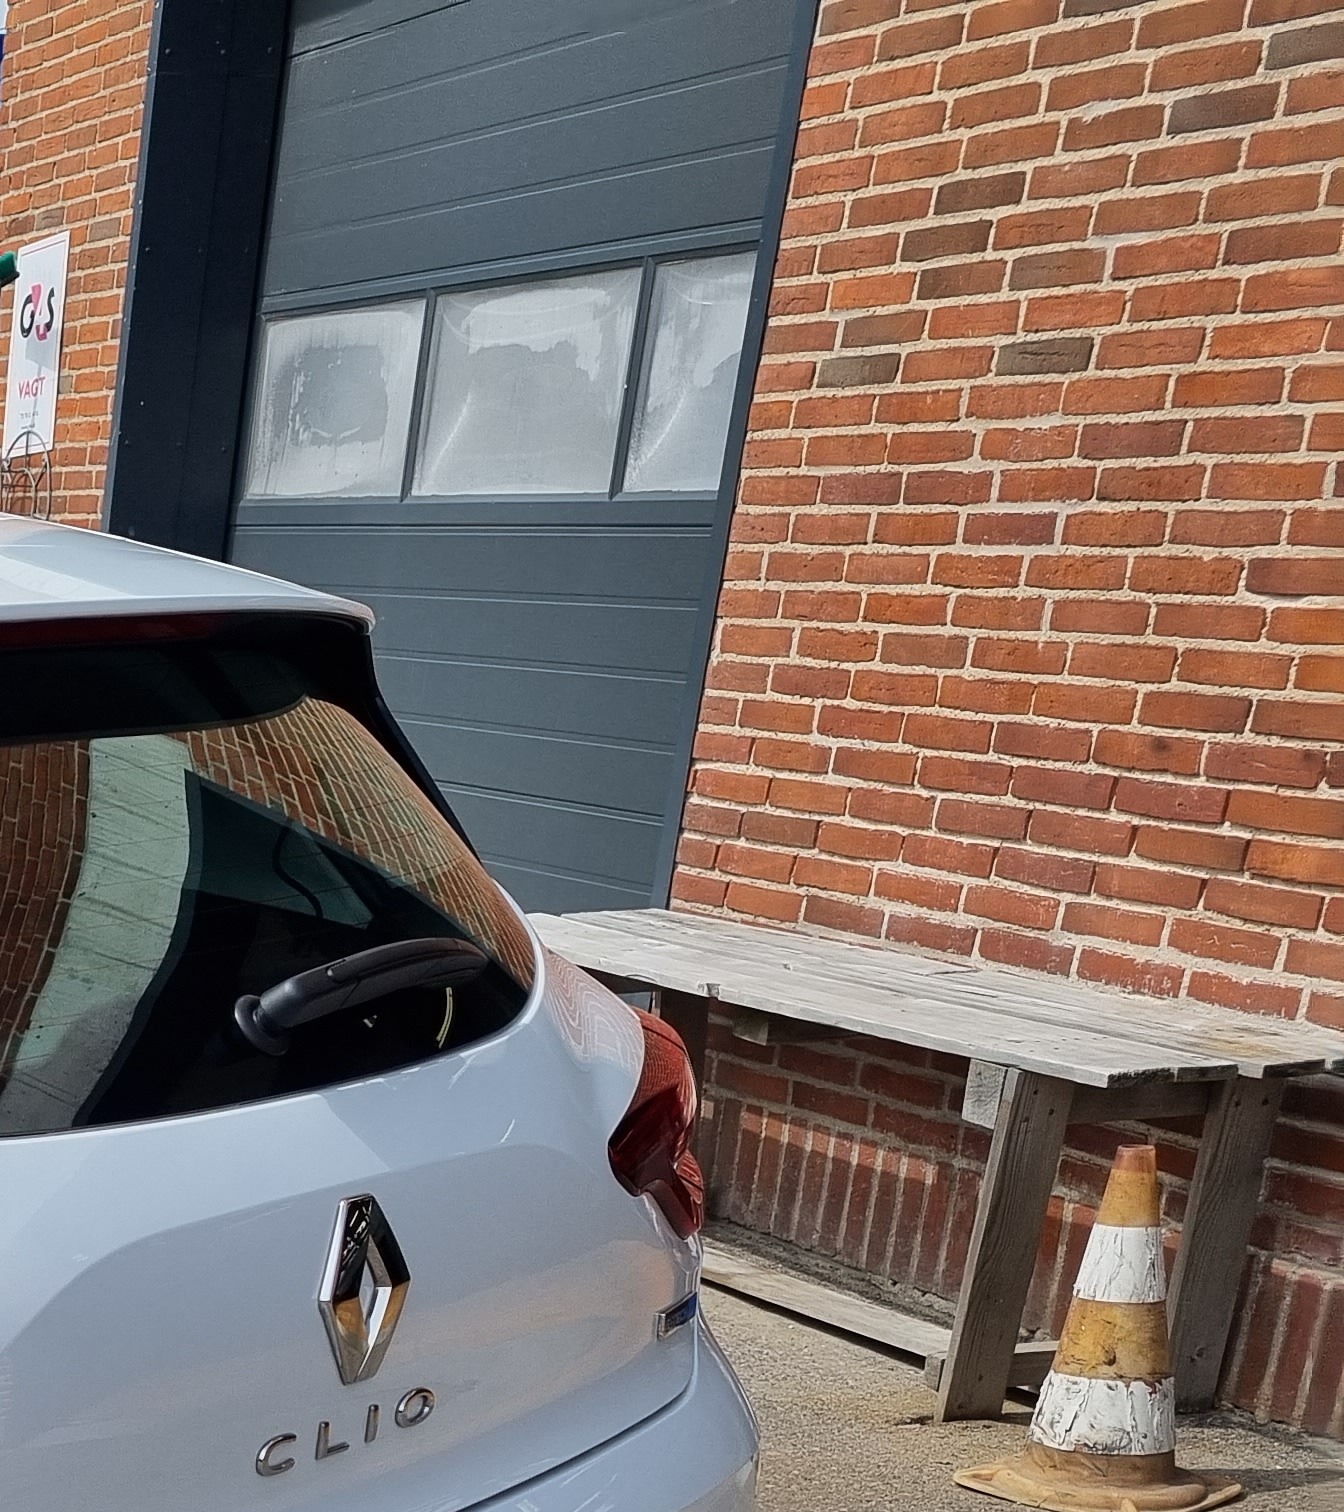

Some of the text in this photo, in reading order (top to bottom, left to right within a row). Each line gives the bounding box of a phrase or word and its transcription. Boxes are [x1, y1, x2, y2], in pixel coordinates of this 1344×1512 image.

[19, 283, 55, 342] G4S
[18, 376, 46, 399] VAGT
[255, 1386, 436, 1477] CLIO
